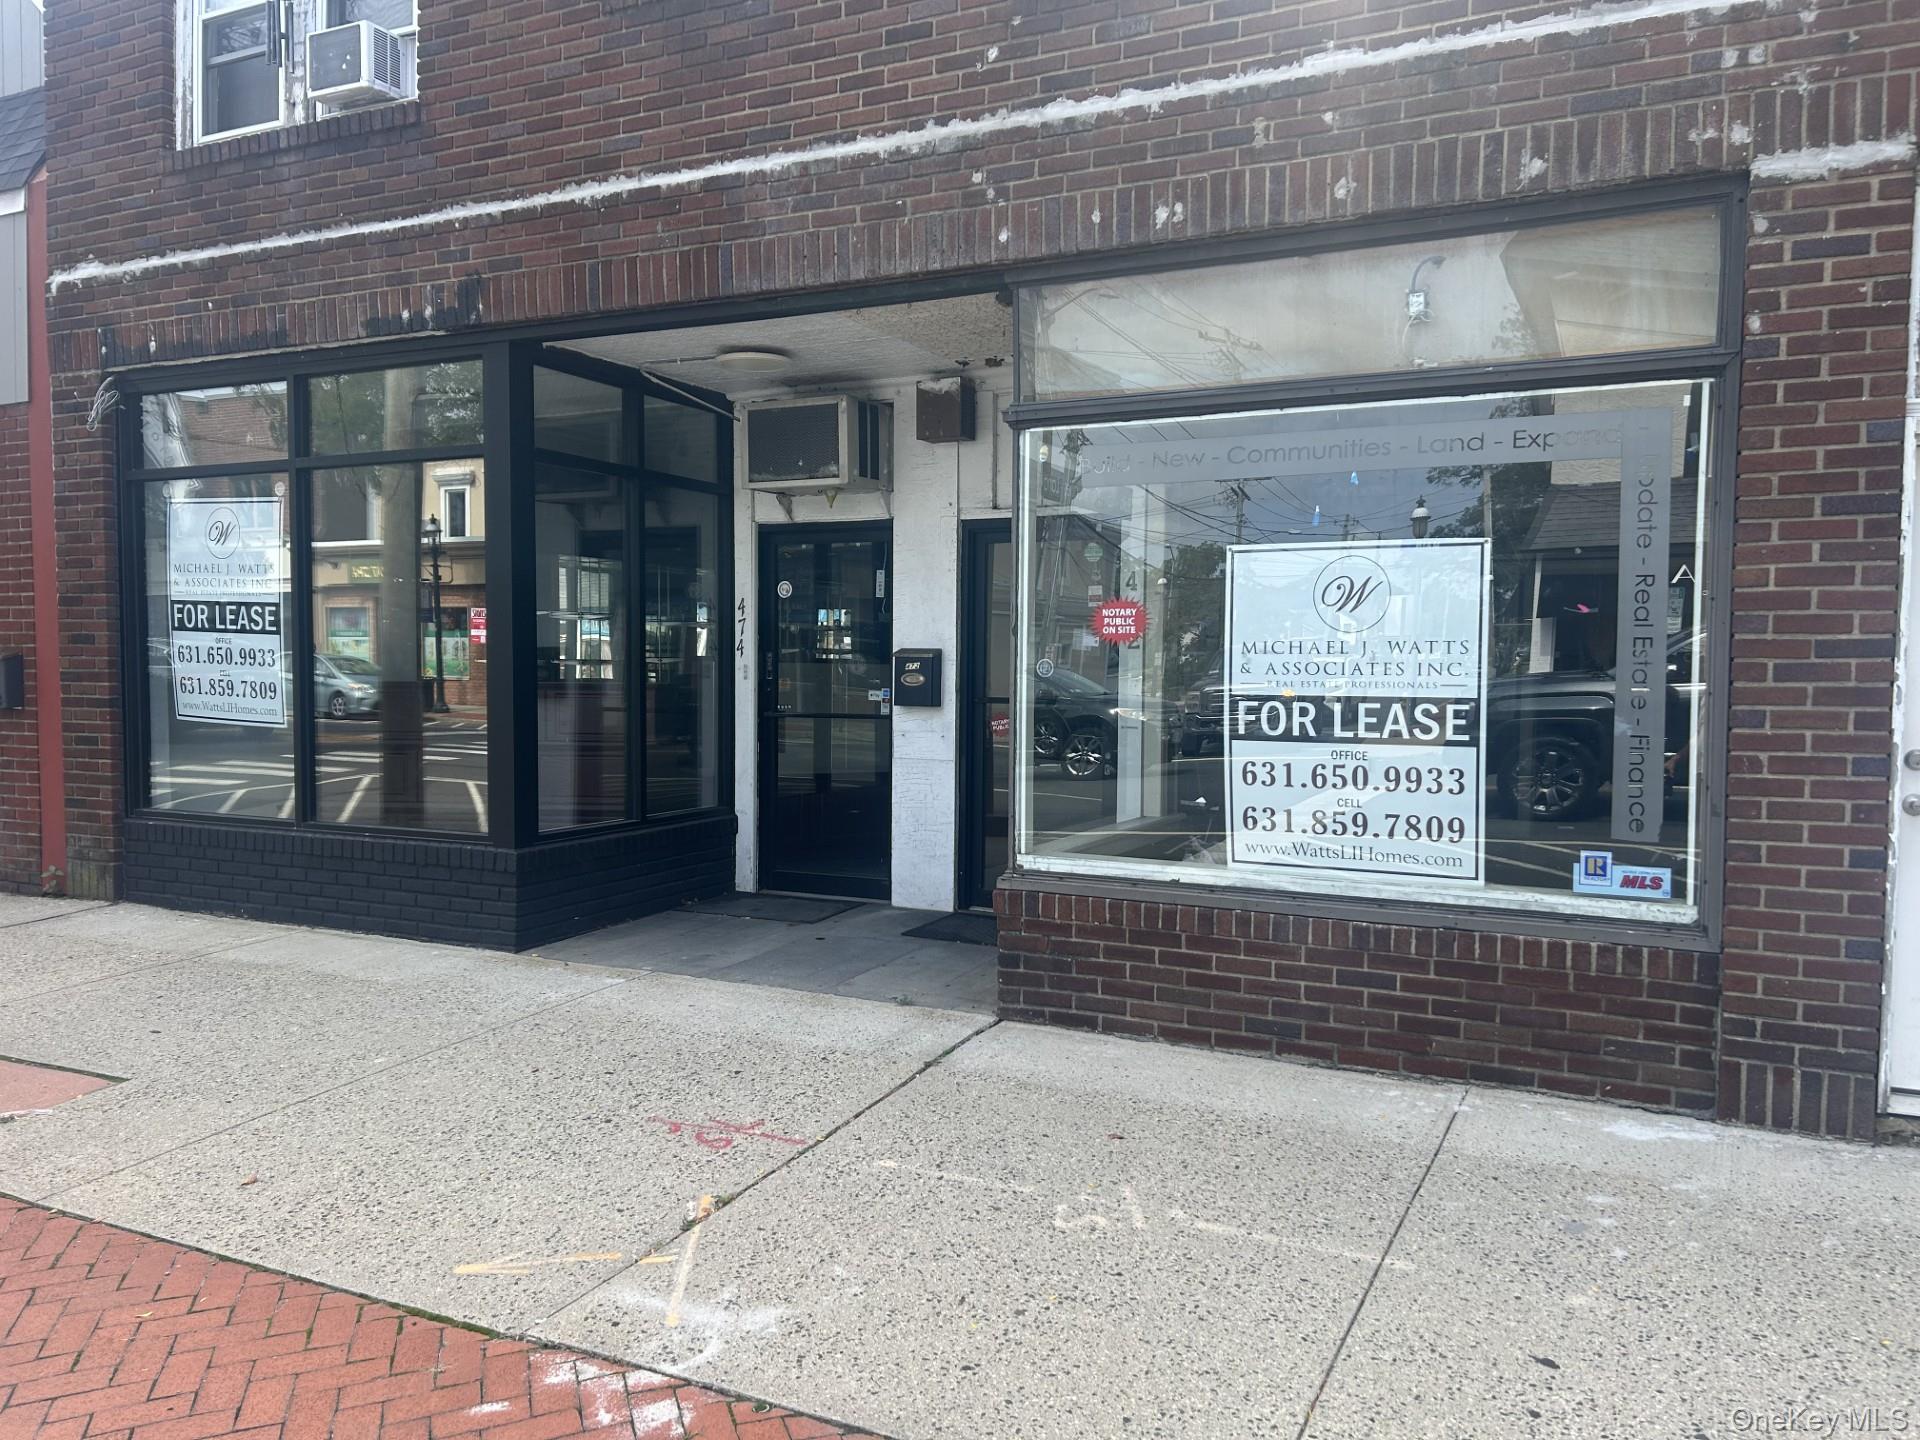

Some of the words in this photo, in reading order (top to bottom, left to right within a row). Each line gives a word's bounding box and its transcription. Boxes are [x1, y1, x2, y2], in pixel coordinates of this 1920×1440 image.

[1152, 449, 1204, 469] New
[1226, 438, 1392, 465] Communities
[1417, 432, 1485, 454] Land
[1512, 424, 1624, 451] Expand
[173, 563, 222, 574] MICHAEL
[238, 563, 275, 574] WATTS
[184, 578, 248, 588] ASSOCIATES
[1633, 574, 1656, 627] Real
[173, 603, 209, 629] FOR
[215, 605, 277, 631] LEASE
[1102, 608, 1137, 617] NOTARY
[1103, 617, 1135, 625] PUBLIC
[736, 597, 746, 658] 474
[1102, 626, 1116, 634] ON
[1117, 626, 1136, 634] SITE
[215, 637, 232, 645] OFFICE
[1241, 640, 1349, 655] MICHAEL
[1361, 640, 1375, 659] J.
[1387, 639, 1470, 655] WATTS
[177, 645, 276, 667] 631.650.9933
[1240, 662, 1252, 674] &
[1265, 661, 1405, 676] ASSOCIATES
[1417, 662, 1470, 677] INC.
[1630, 636, 1654, 710] Estate
[180, 676, 277, 700] 631.859.7809
[1267, 680, 1296, 688] REAL
[1301, 680, 1340, 688] ESTATE
[1344, 680, 1439, 690] PROFESSIONALS
[182, 701, 278, 716] www.WattsLIHomes.com
[1237, 700, 1317, 737] FOR
[1333, 702, 1471, 741] LEASE
[1331, 750, 1369, 761] OFFICE
[1241, 760, 1466, 796] 631.650.9933
[1627, 735, 1651, 834] Finance
[1337, 798, 1363, 809] CELL
[1242, 805, 1466, 844] 631.859.7809
[1244, 841, 1464, 868] www.WattsLIHomes.com
[1620, 875, 1663, 890] MLS
